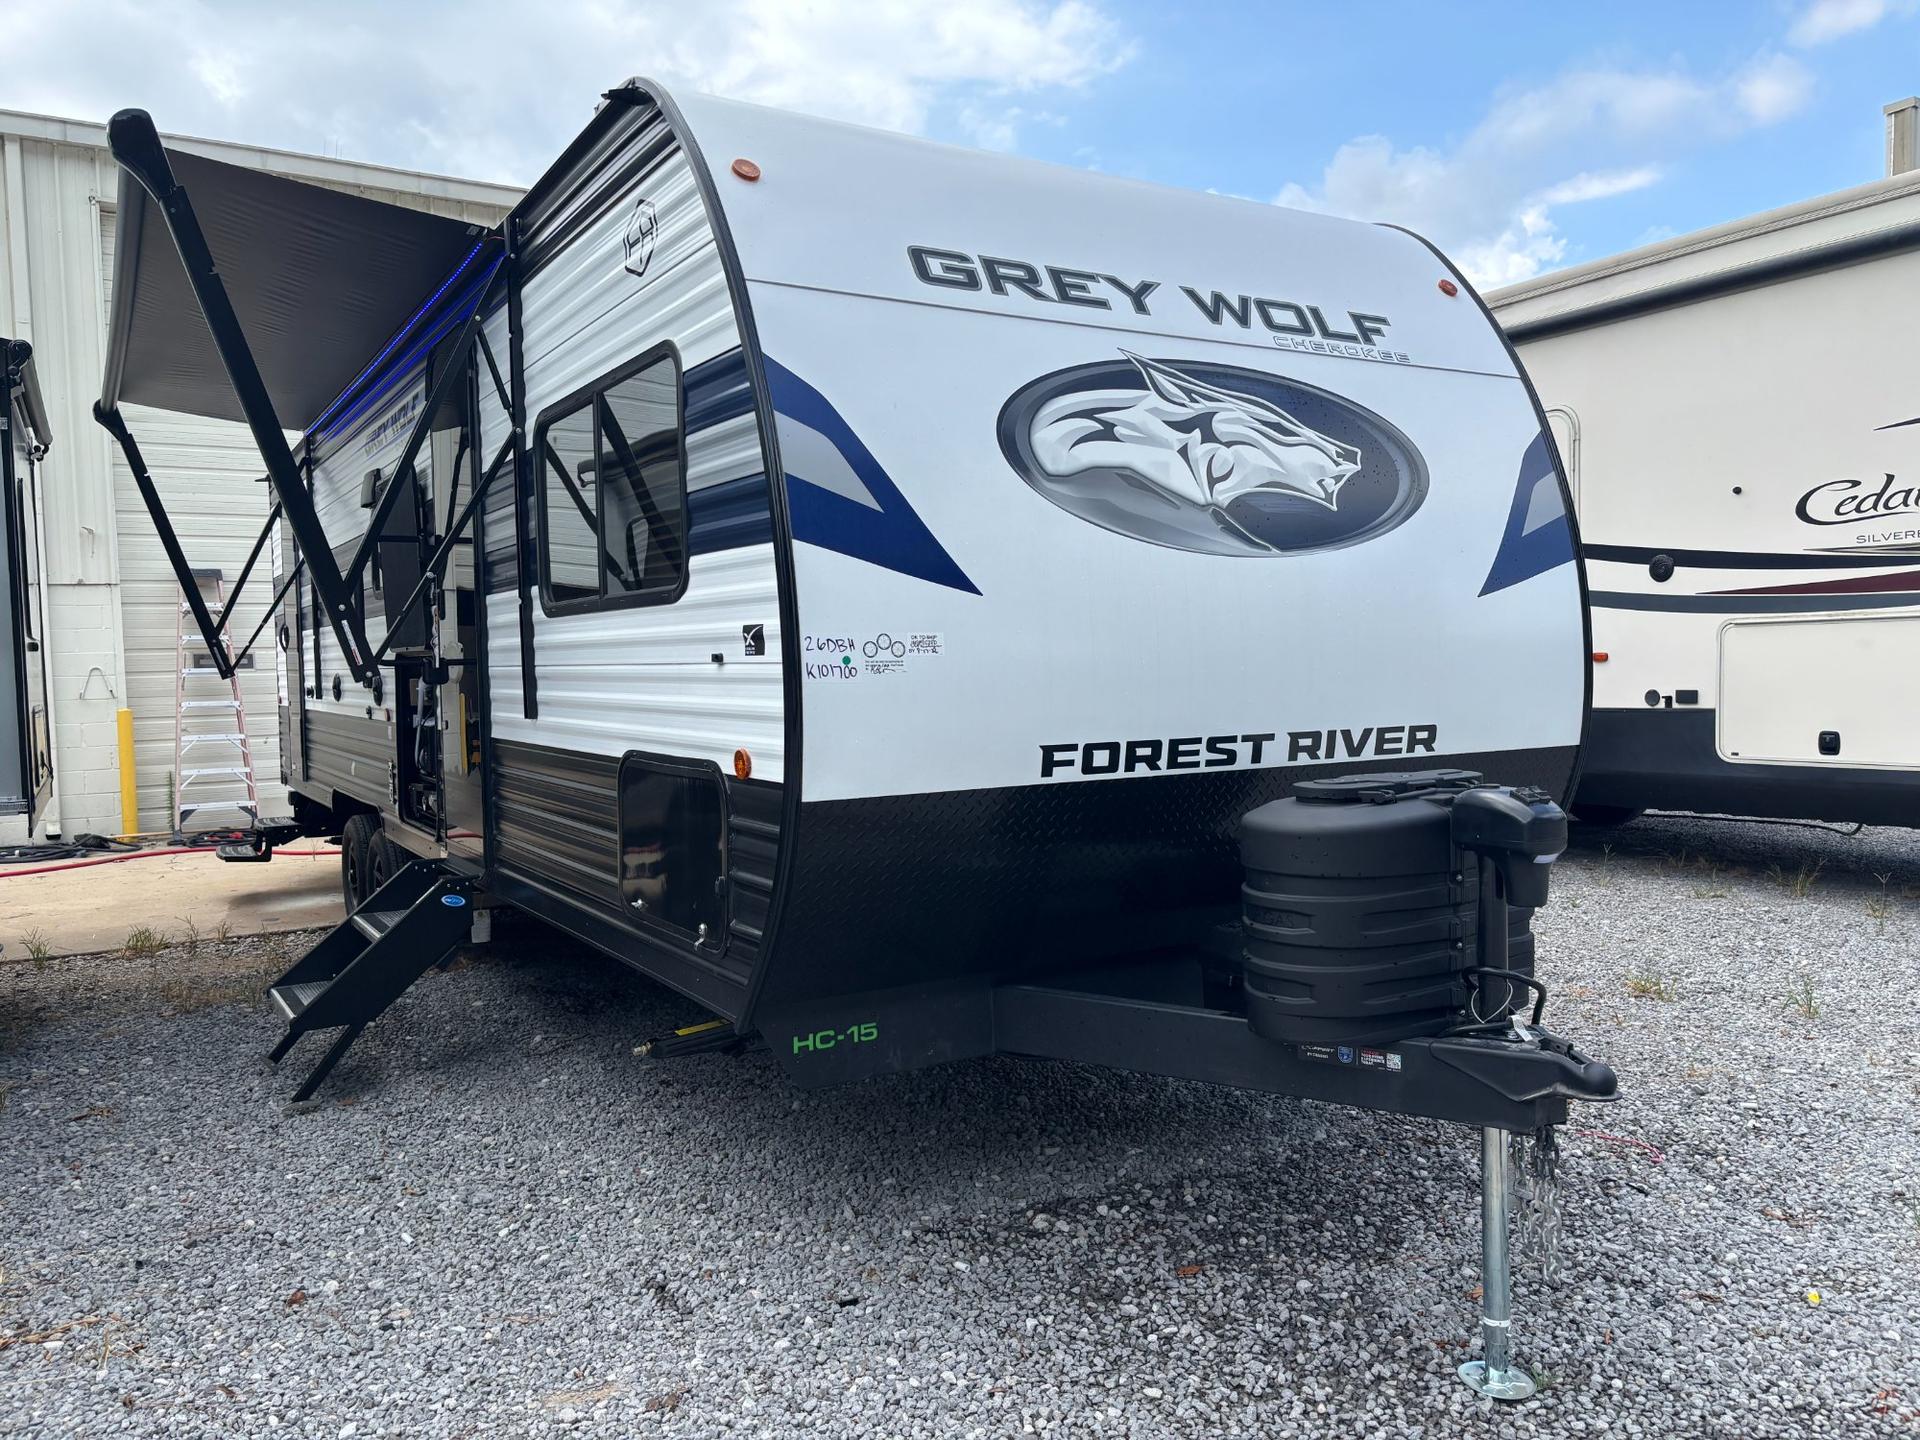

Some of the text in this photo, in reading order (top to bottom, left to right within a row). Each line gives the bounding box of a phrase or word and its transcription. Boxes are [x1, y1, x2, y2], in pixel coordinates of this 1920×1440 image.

[906, 245, 1392, 346] GREY WOLF
[1272, 335, 1411, 363] CHEROKEE
[804, 636, 856, 652] 26DBH
[1039, 724, 1438, 777] FOREST RIVER
[793, 1022, 878, 1054] HC-15
